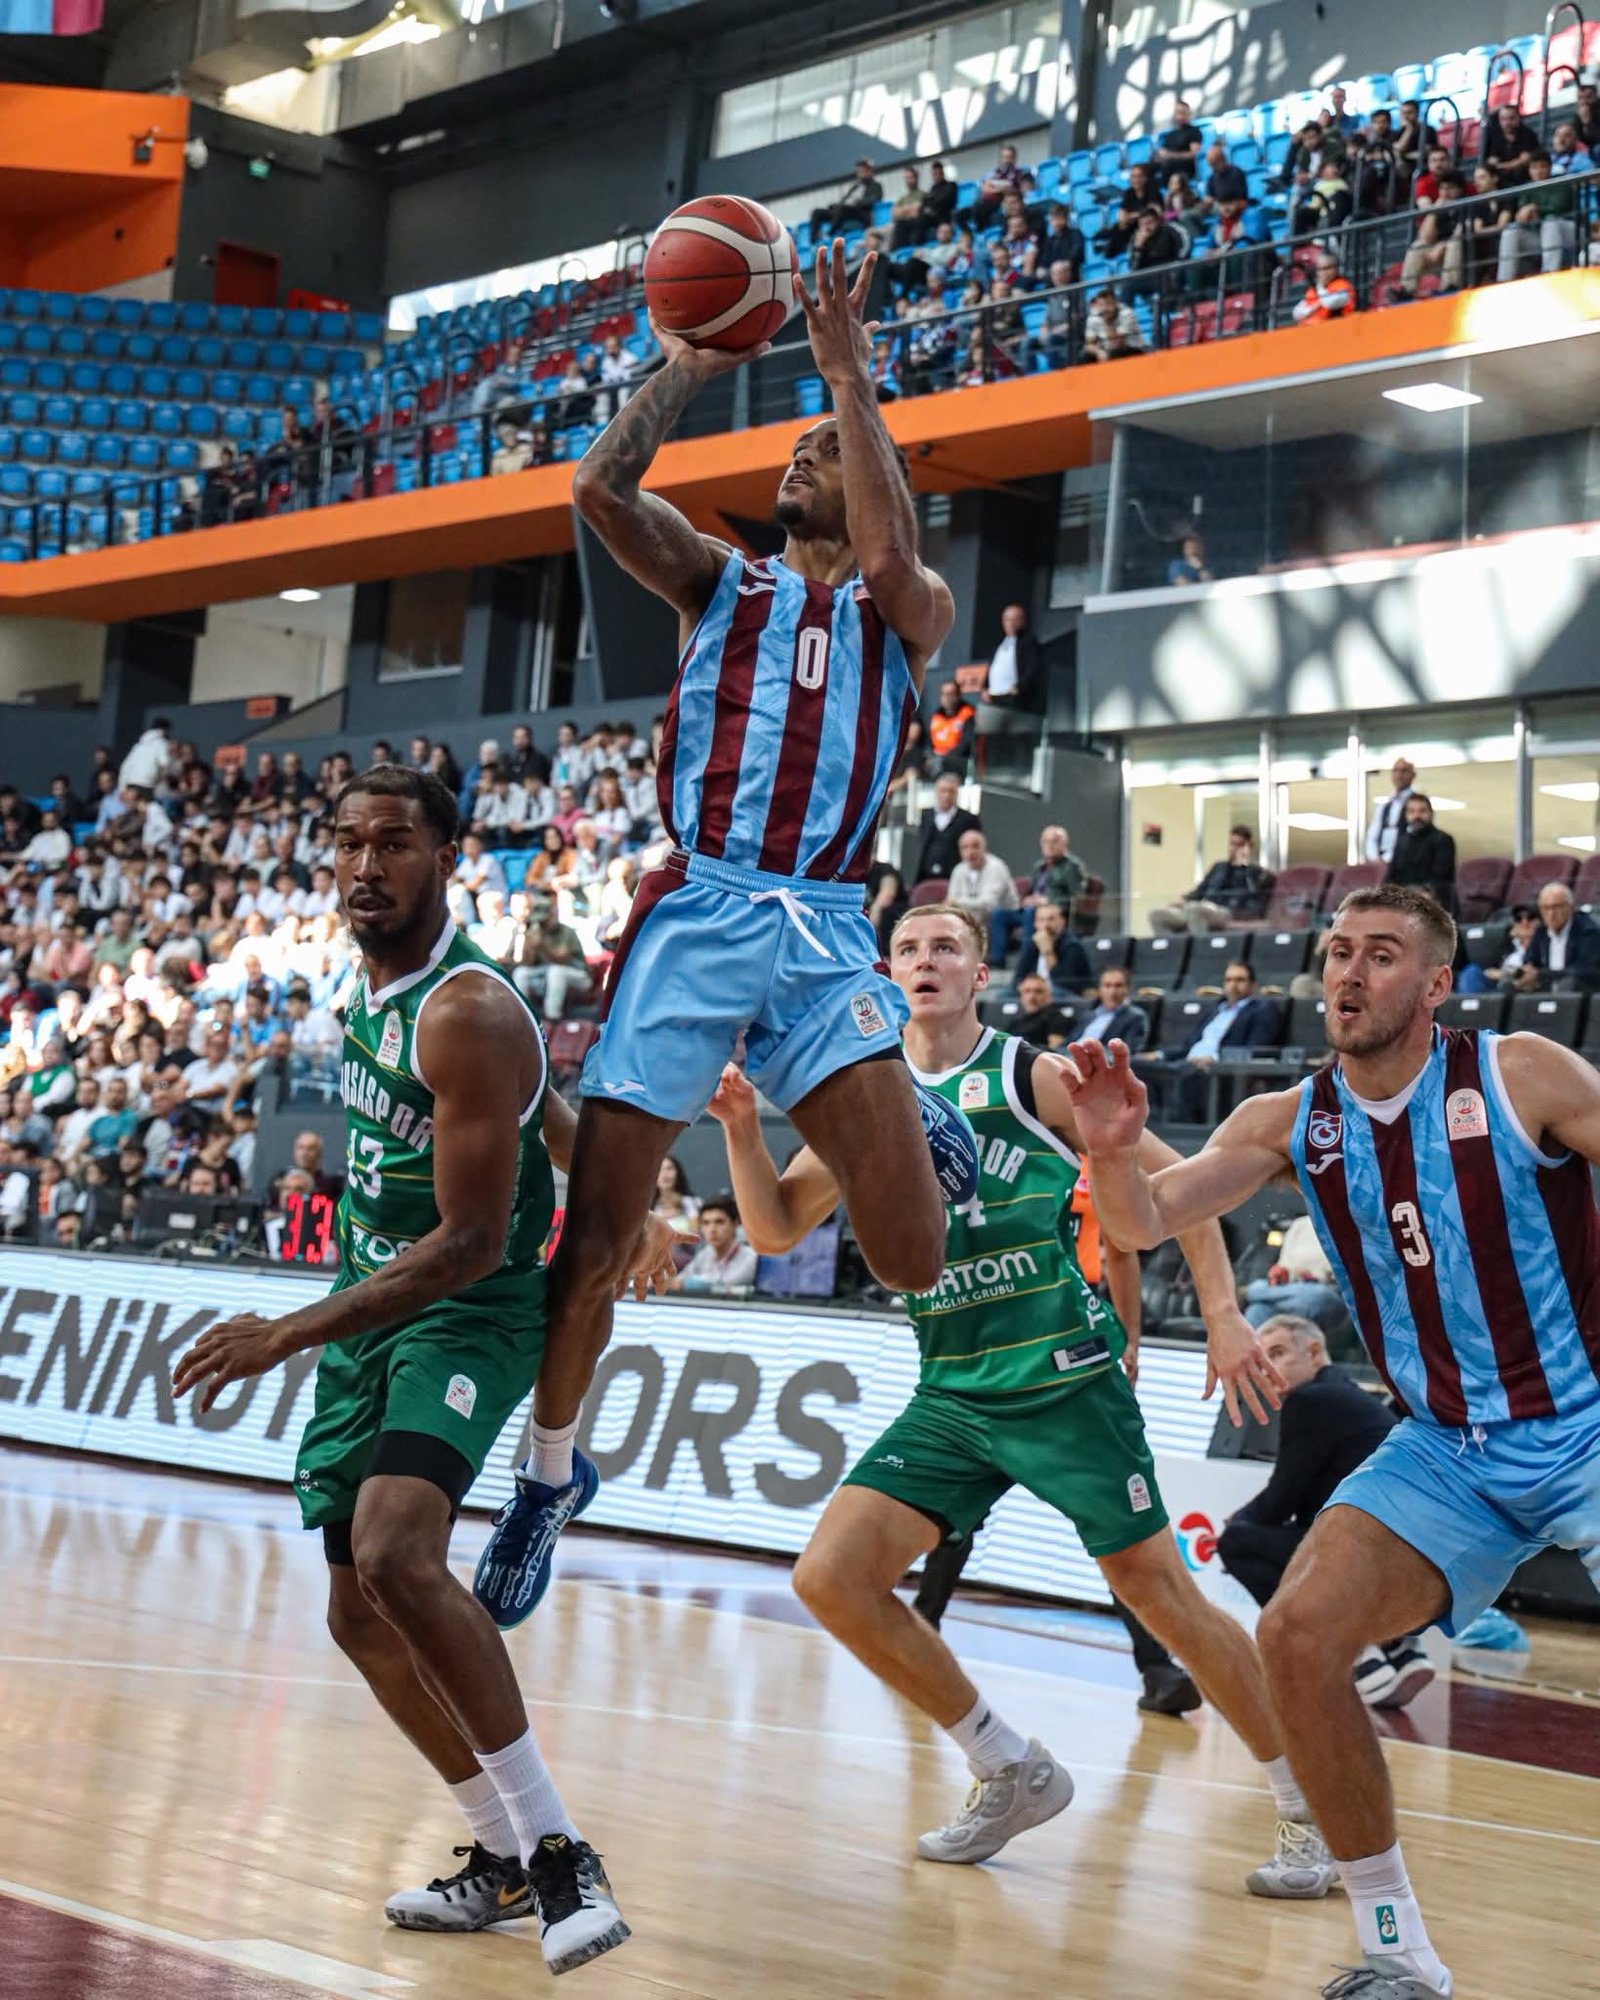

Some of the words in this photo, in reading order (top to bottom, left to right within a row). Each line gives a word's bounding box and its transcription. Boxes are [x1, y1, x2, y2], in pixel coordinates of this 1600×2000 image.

[796, 626, 829, 690] 0
[1391, 1201, 1431, 1267] 3
[972, 1282, 1016, 1301] GRUBU
